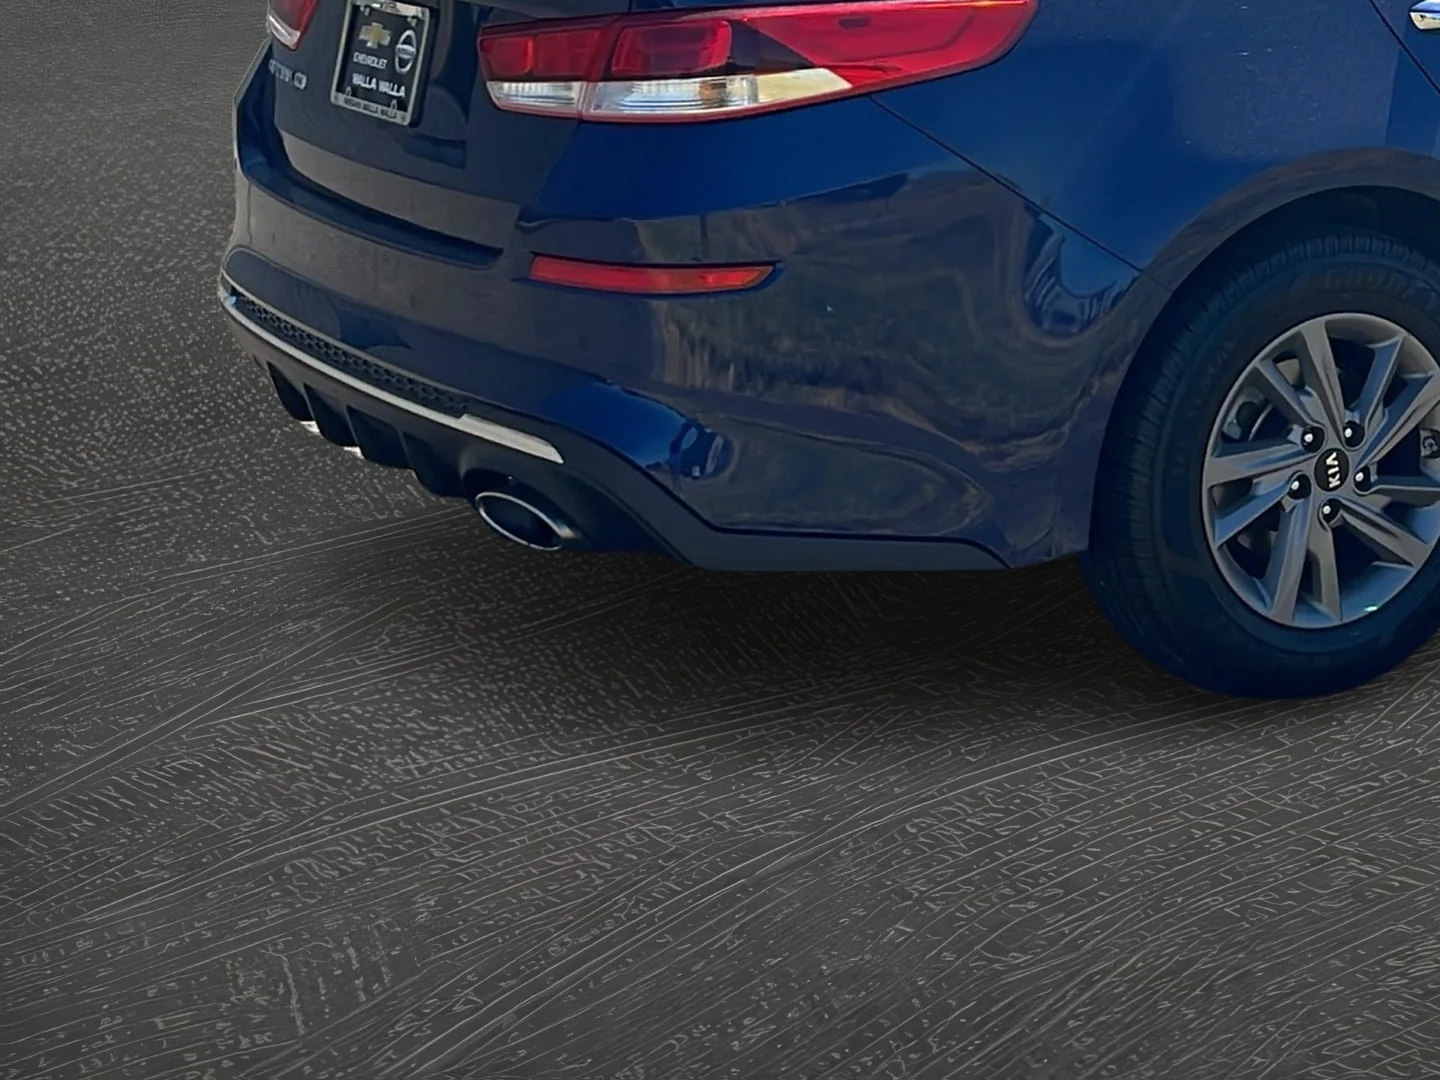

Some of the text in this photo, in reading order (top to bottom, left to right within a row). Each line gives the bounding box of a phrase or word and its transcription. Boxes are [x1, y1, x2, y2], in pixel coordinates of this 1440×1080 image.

[353, 52, 388, 70] CHEVROLET
[352, 73, 406, 98] WALLA WALLA
[1325, 451, 1341, 488] KIA
